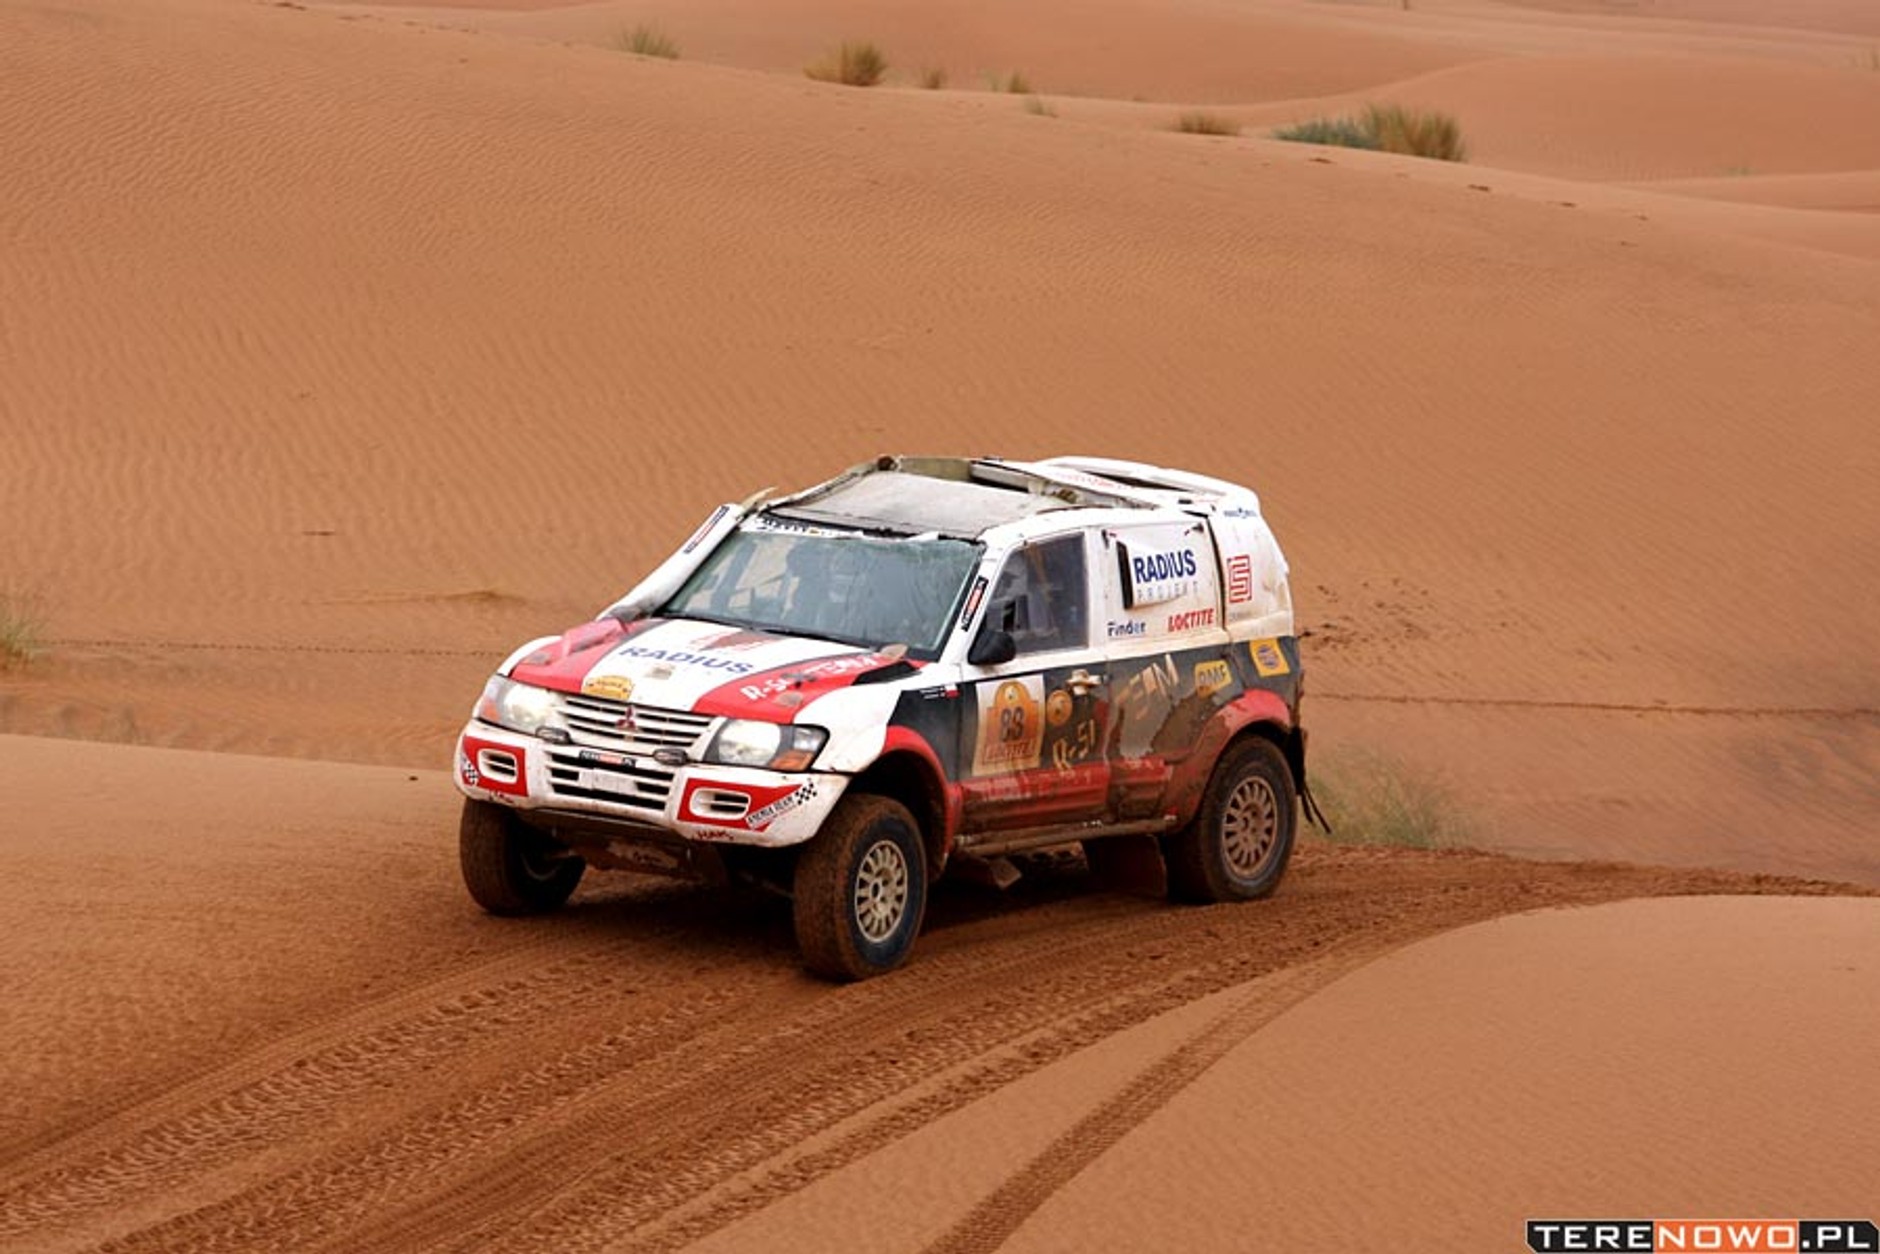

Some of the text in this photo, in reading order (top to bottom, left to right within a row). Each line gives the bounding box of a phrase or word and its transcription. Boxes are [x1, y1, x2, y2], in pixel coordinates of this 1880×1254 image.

[1132, 549, 1197, 584] RADIUS
[1167, 608, 1215, 633] LOCTITE
[618, 646, 754, 674] RADIUS
